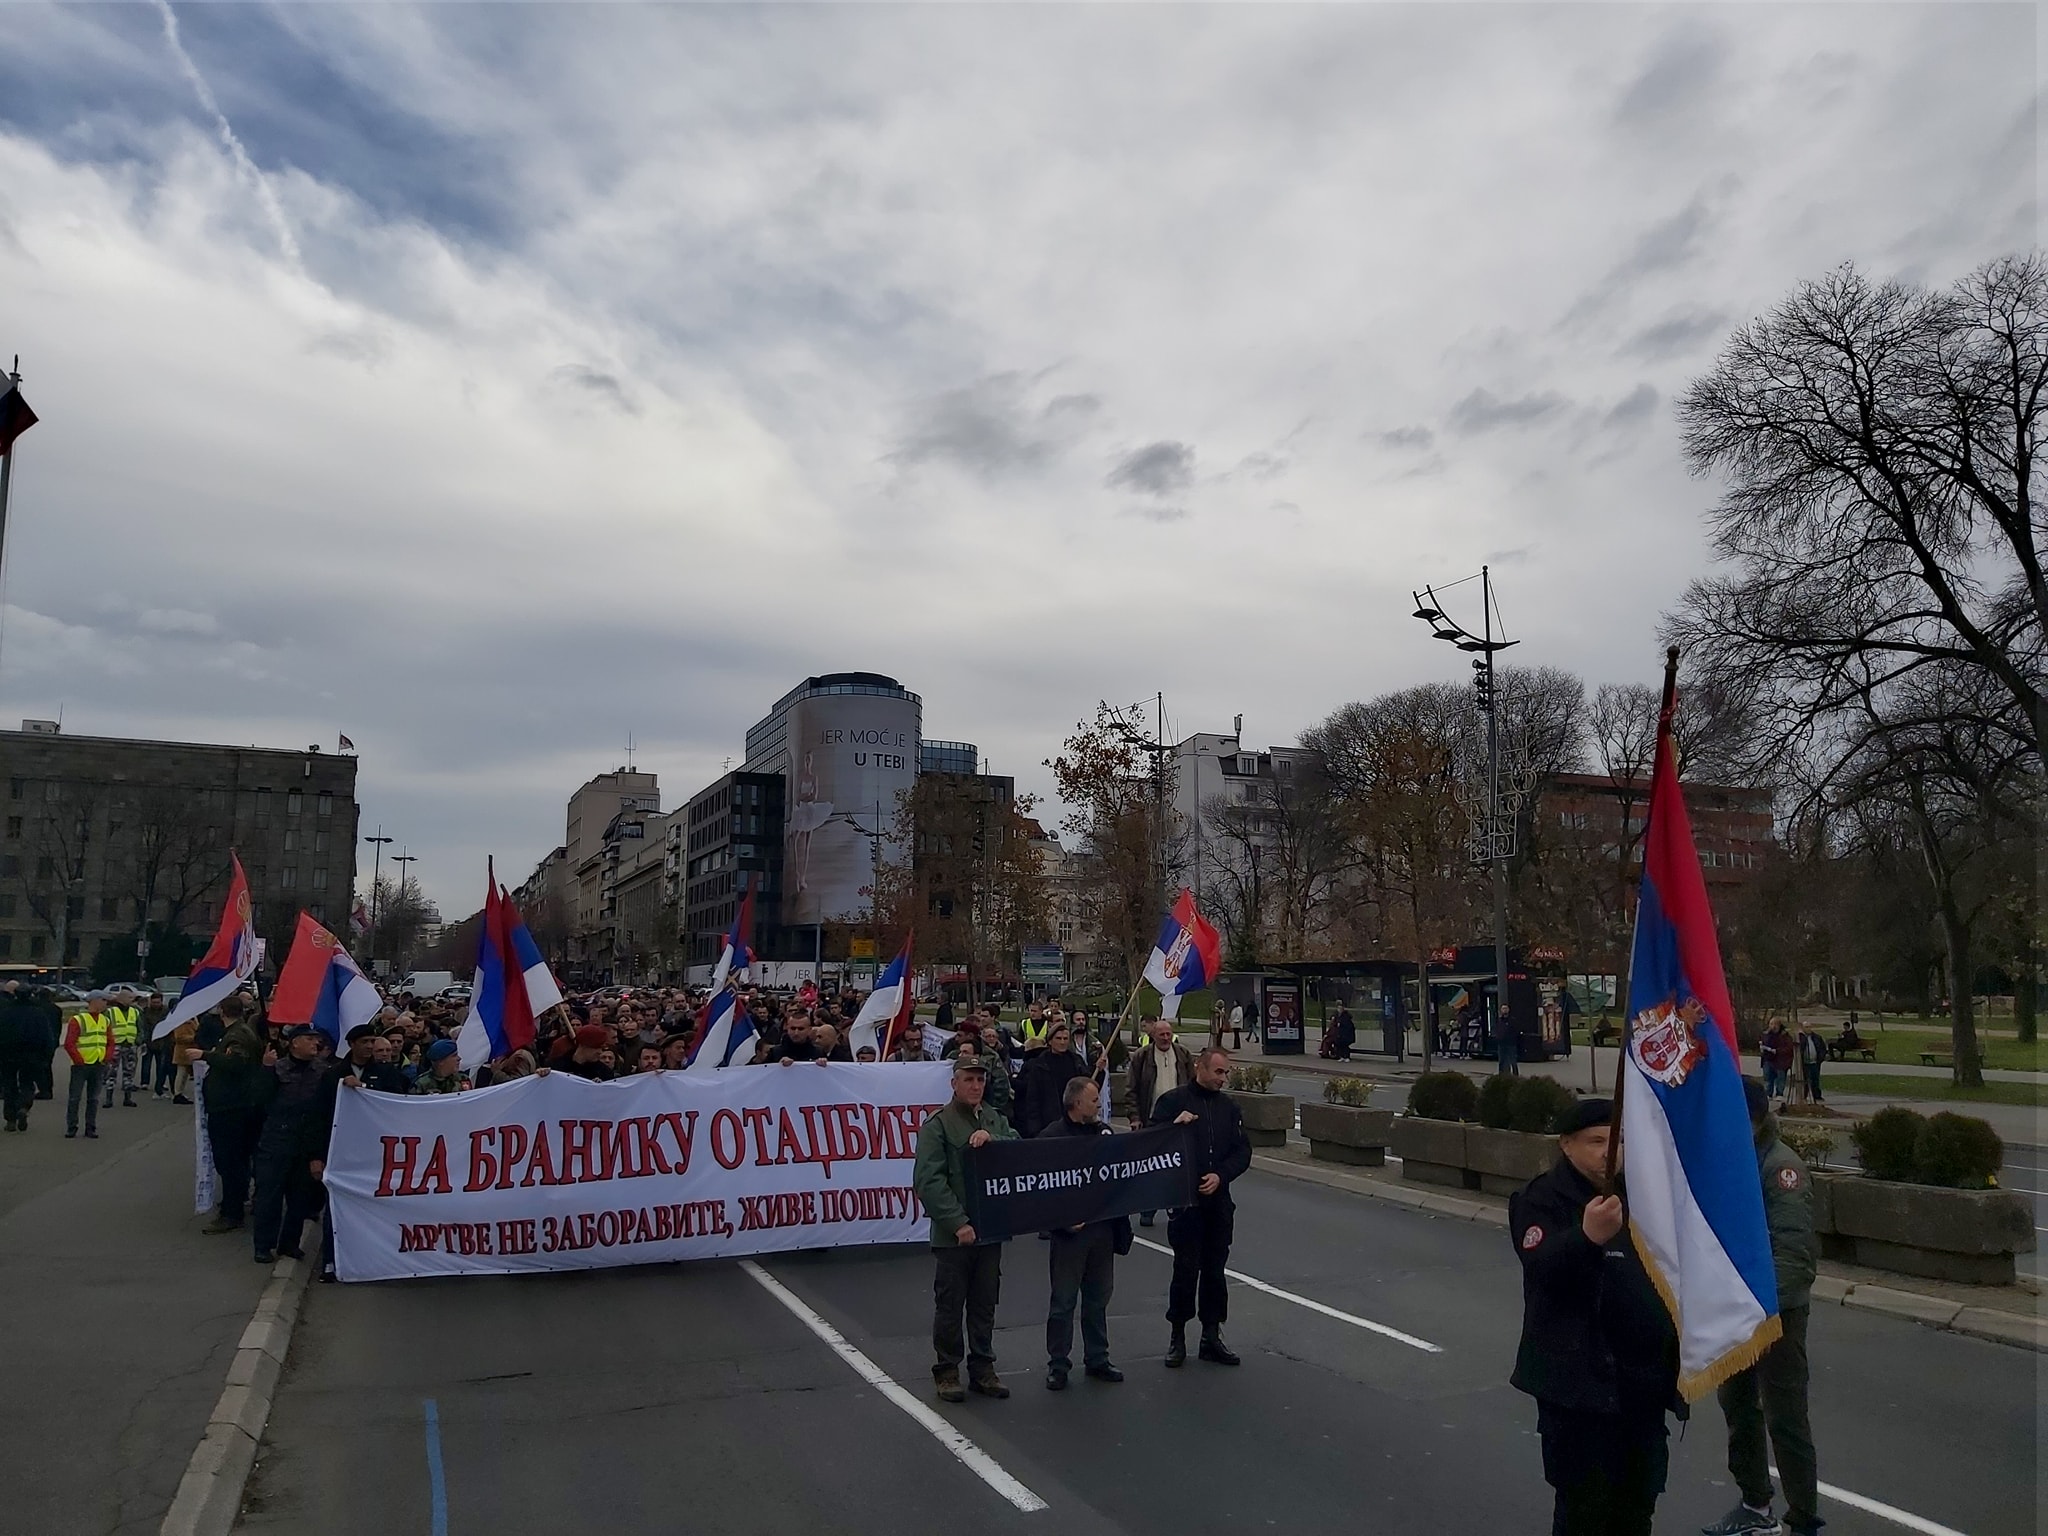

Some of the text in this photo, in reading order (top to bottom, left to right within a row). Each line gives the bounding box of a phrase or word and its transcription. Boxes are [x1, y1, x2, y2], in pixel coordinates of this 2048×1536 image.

[820, 728, 906, 748] JER MOĆ JE
[855, 753, 905, 769] U TEBI
[794, 969, 811, 979] JER
[374, 1135, 452, 1197] НА
[463, 1110, 700, 1193] БРАНИКУ
[984, 1177, 1011, 1196] НА
[1015, 1166, 1094, 1193] БРАНИКУ
[399, 1186, 932, 1255] МРТВЕ НЕ ЗАБОРАВИТЕ, ЖИВЕ ПОШТУЈ
